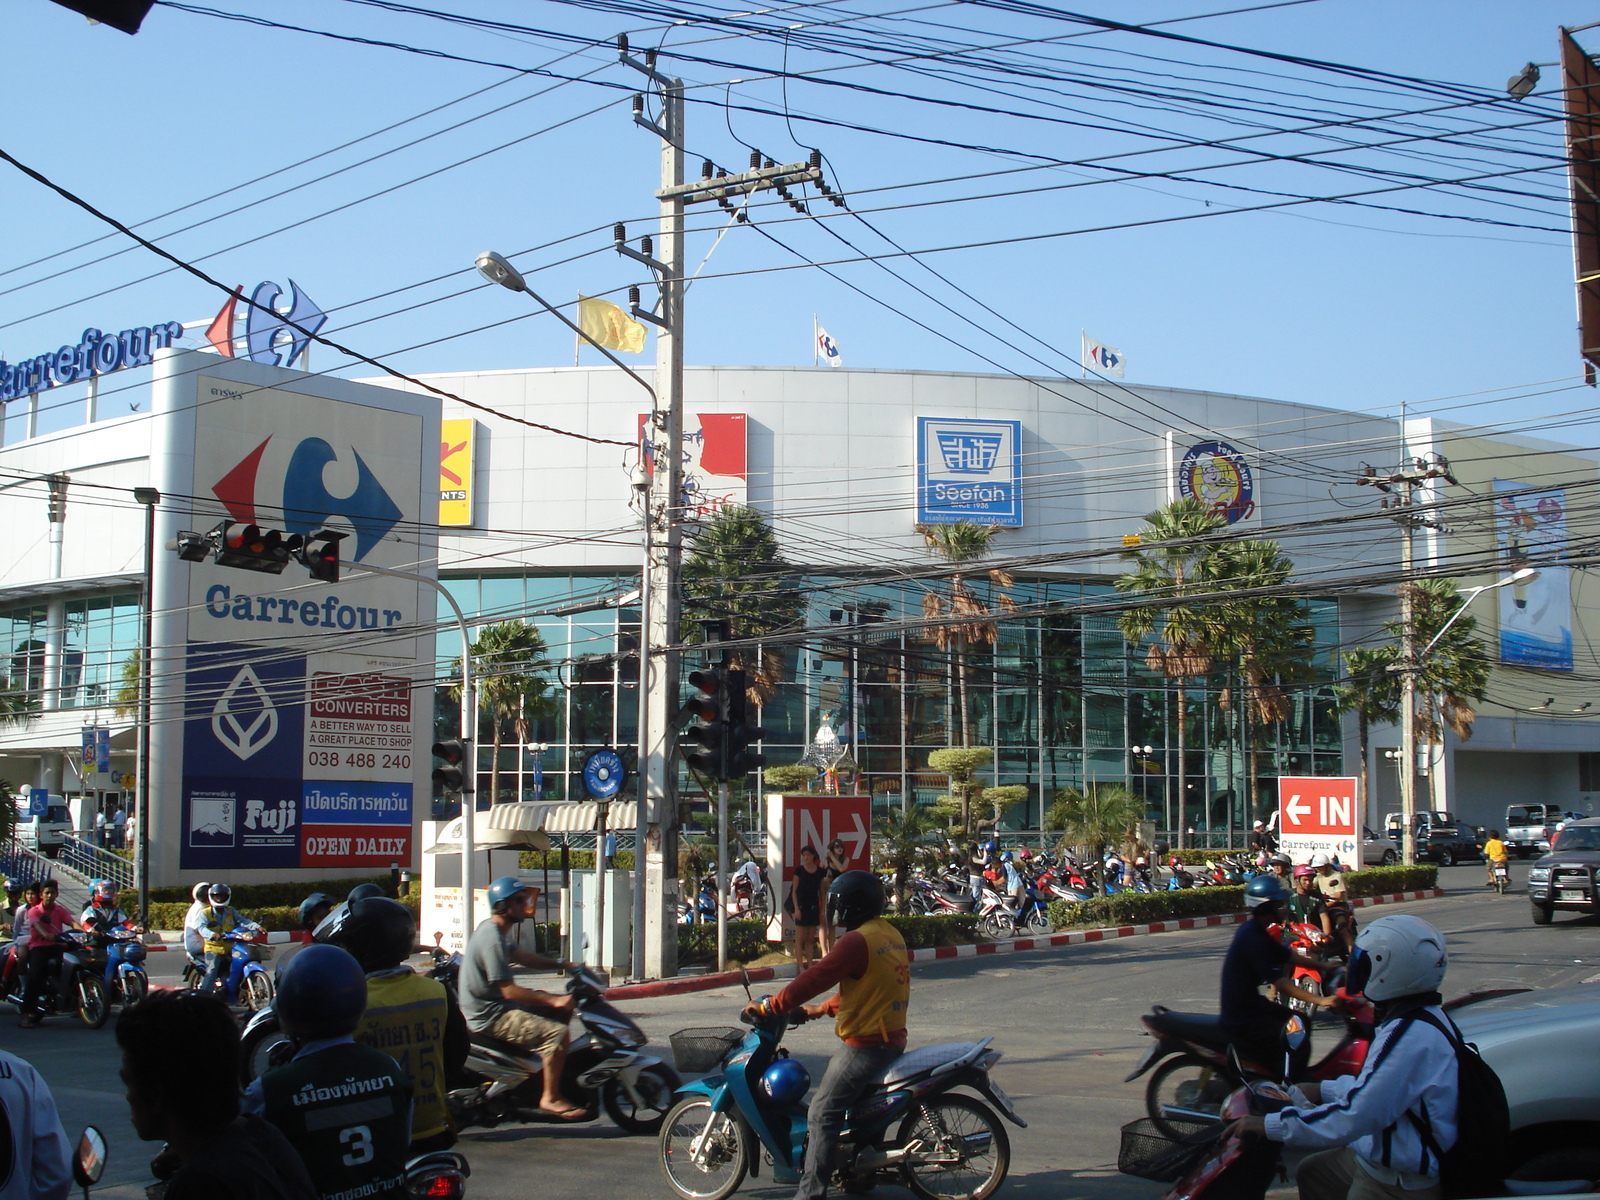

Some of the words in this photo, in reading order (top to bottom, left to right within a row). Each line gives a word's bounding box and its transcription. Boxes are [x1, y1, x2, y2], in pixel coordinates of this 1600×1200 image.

[0, 320, 184, 402] arrefour
[935, 483, 1005, 502] Seefah
[205, 583, 402, 632] Carrefour
[315, 700, 409, 717] CONVERTERS
[310, 720, 318, 729] A
[319, 721, 355, 731] BETTER
[356, 723, 377, 732] WAY
[377, 723, 388, 732] TO
[390, 724, 411, 734] SELL
[309, 735, 317, 743] A
[318, 735, 347, 745] GREAT
[348, 736, 375, 746] PLACE
[376, 737, 388, 746] TO
[389, 737, 412, 747] SHOP
[309, 752, 339, 767] 038
[346, 753, 376, 768] 488
[382, 754, 411, 769] 240
[243, 799, 297, 834] Fuji
[305, 790, 408, 817] เปิดบริการทุกวัน
[1319, 796, 1351, 826] IN
[306, 837, 352, 856] OPEN
[355, 838, 406, 856] DAILY
[785, 809, 830, 867] IN
[1281, 840, 1331, 850] Carrefour
[292, 1074, 395, 1107] เมืองพัทยา
[338, 1125, 375, 1167] 3
